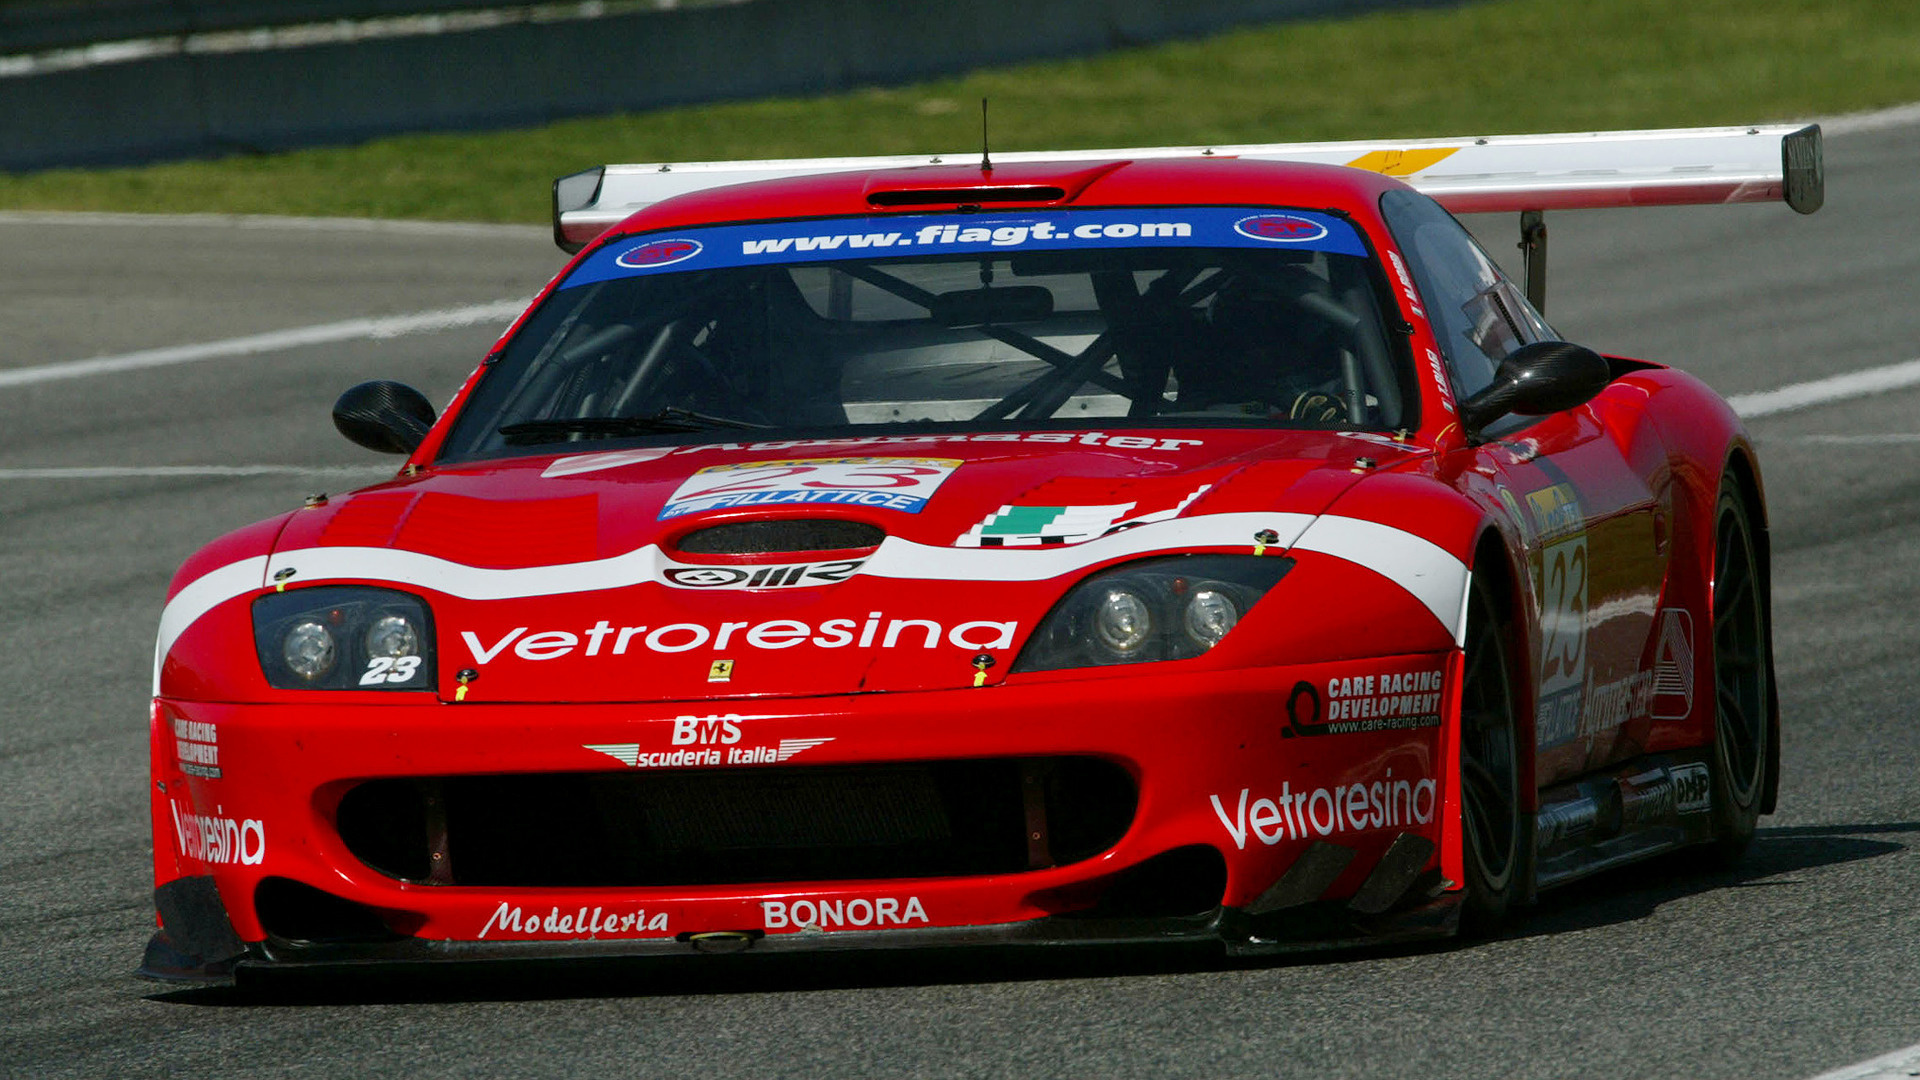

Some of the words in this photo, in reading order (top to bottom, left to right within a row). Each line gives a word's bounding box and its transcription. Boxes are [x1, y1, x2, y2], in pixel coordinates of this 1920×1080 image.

[742, 221, 1192, 256] www.fiagt.com
[673, 431, 1204, 455] Agrimaster
[676, 466, 942, 501] 23
[709, 488, 922, 511] FILLATTICE
[1543, 543, 1587, 678] 23
[461, 611, 1018, 665] Vetroresina
[358, 655, 422, 686] 23
[1327, 675, 1375, 699] CARE
[1380, 670, 1442, 696] RACING
[1327, 692, 1441, 721] DEVELOPMENT
[671, 714, 743, 745] BMS
[1327, 714, 1440, 735] www.care-racing.com
[637, 748, 721, 768] scuderia
[728, 746, 778, 765] italia
[1209, 767, 1437, 850] Vetroresina
[477, 901, 668, 939] Modelleria
[763, 896, 929, 929] BONORA
